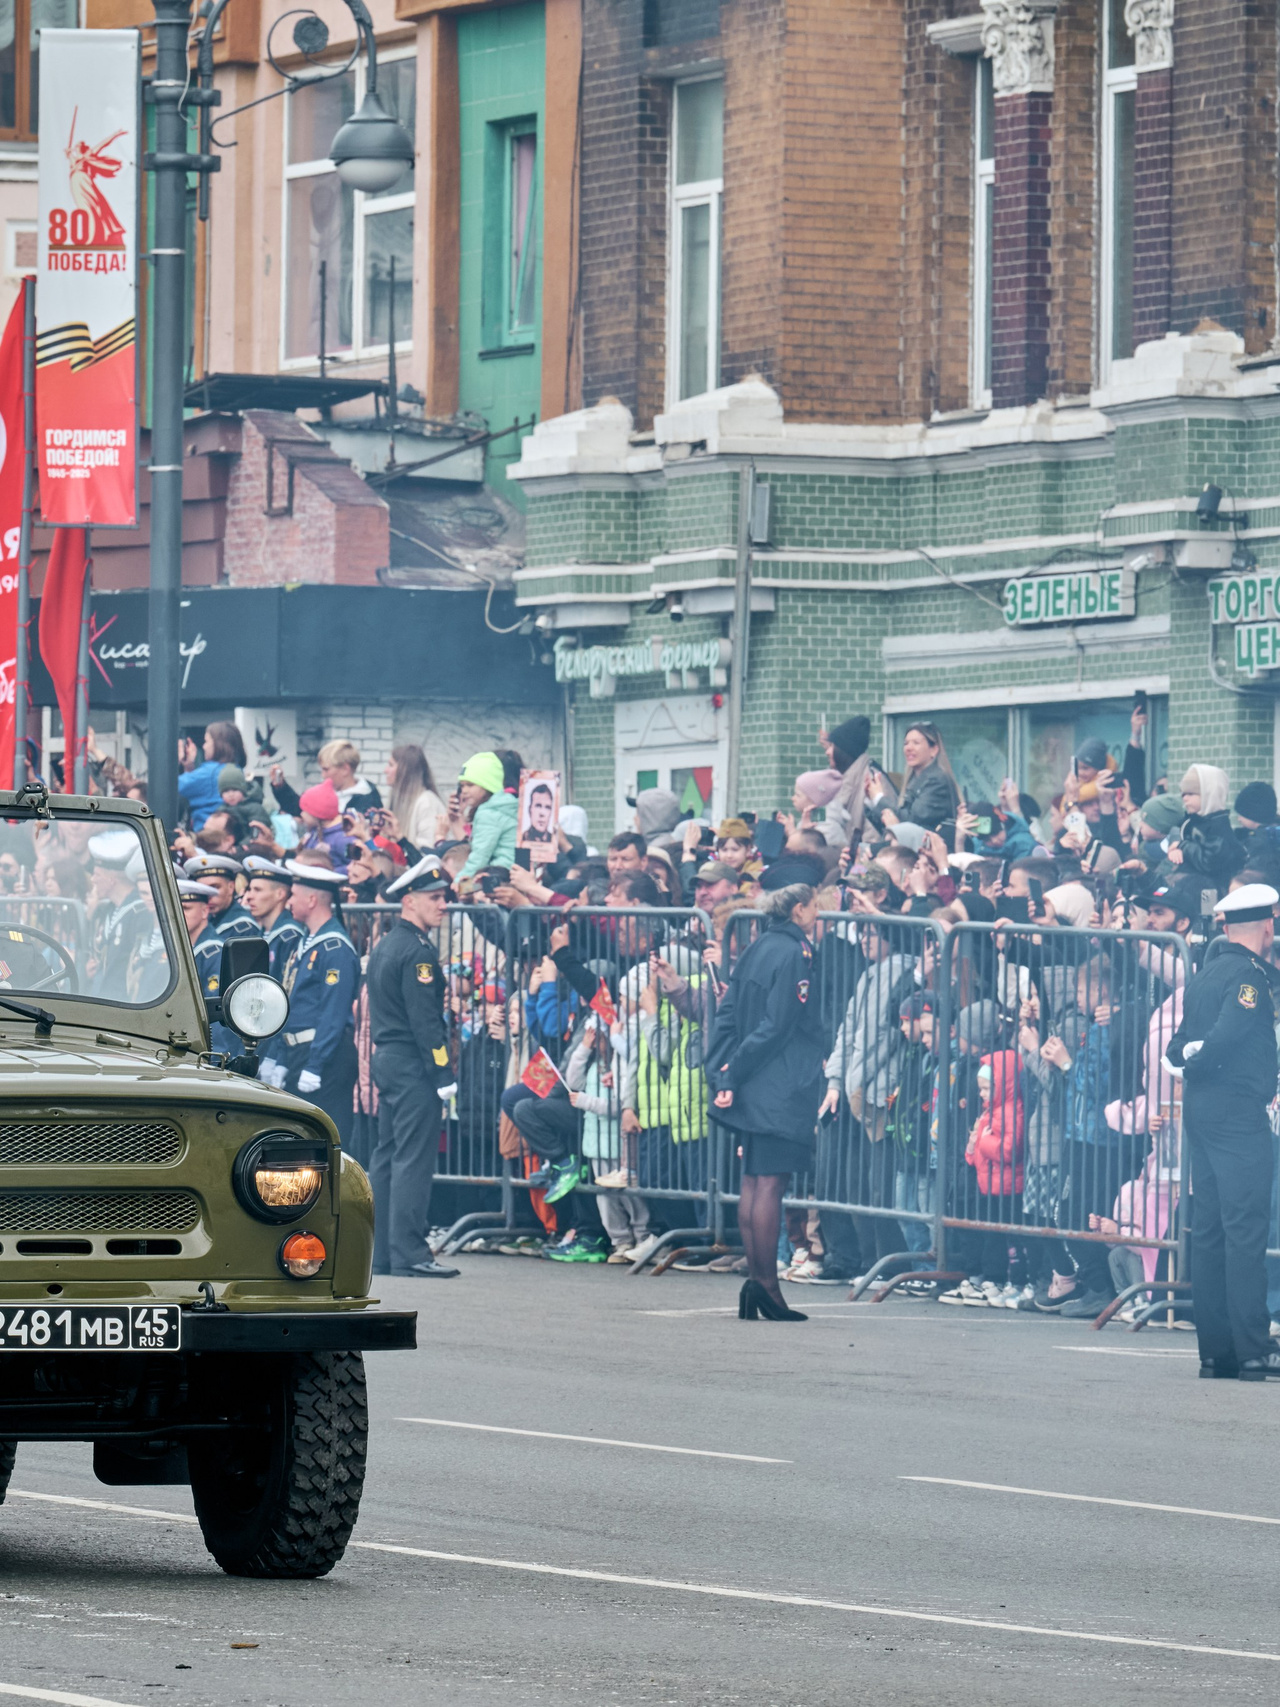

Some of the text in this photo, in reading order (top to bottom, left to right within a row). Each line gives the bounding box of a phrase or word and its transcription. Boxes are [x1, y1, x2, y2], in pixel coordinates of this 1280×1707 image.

[48, 208, 90, 246] 80
[47, 252, 127, 275] ПОБЕДА!
[45, 428, 127, 449] ГОРДИМСЯ
[45, 447, 120, 469] ПОБЕДОЙ!
[1005, 573, 1121, 622] ЗЕЛЕНЫЕ
[134, 1308, 169, 1336] 45
[139, 1336, 165, 1347] RUS
